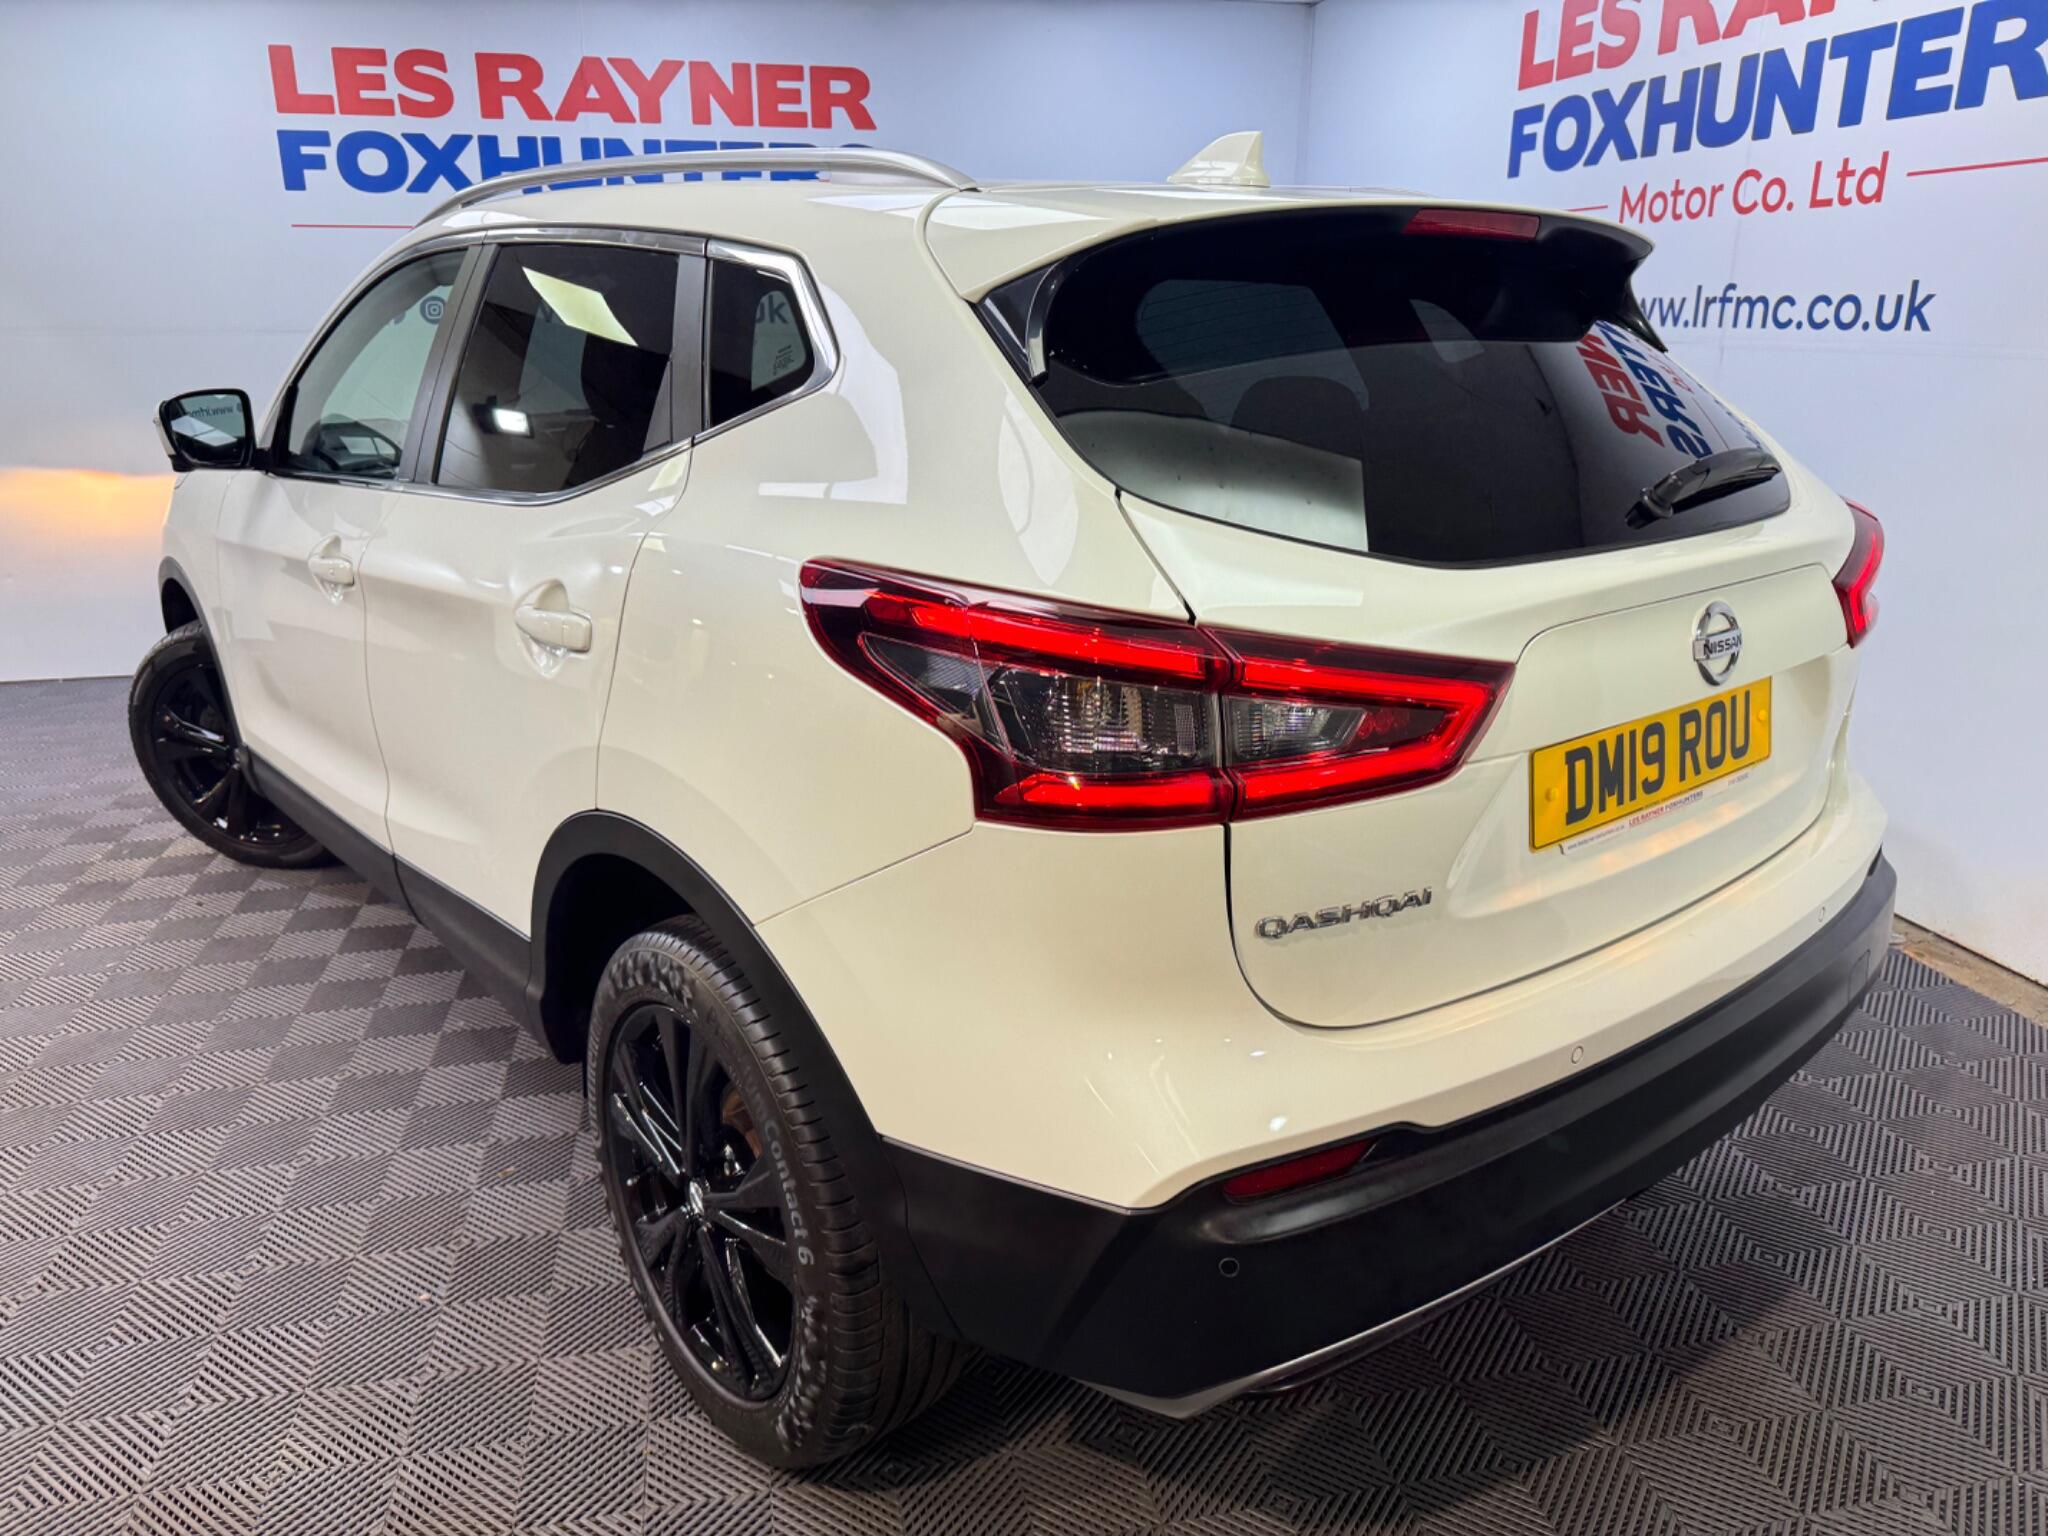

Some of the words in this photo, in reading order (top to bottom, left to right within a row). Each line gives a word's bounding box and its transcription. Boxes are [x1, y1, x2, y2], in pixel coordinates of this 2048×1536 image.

[1518, 0, 1642, 90] LES
[267, 44, 454, 118] LES
[474, 51, 877, 131] RAYNER
[1618, 178, 1725, 225] Motor
[1732, 168, 1795, 215] Co.
[1808, 151, 1890, 210] Ltd
[1703, 633, 1744, 657] NISSAN
[1564, 721, 1666, 826] DM19
[1679, 689, 1751, 783] ROU
[1254, 886, 1432, 939] QASHQAI
[798, 1246, 815, 1266] 6
